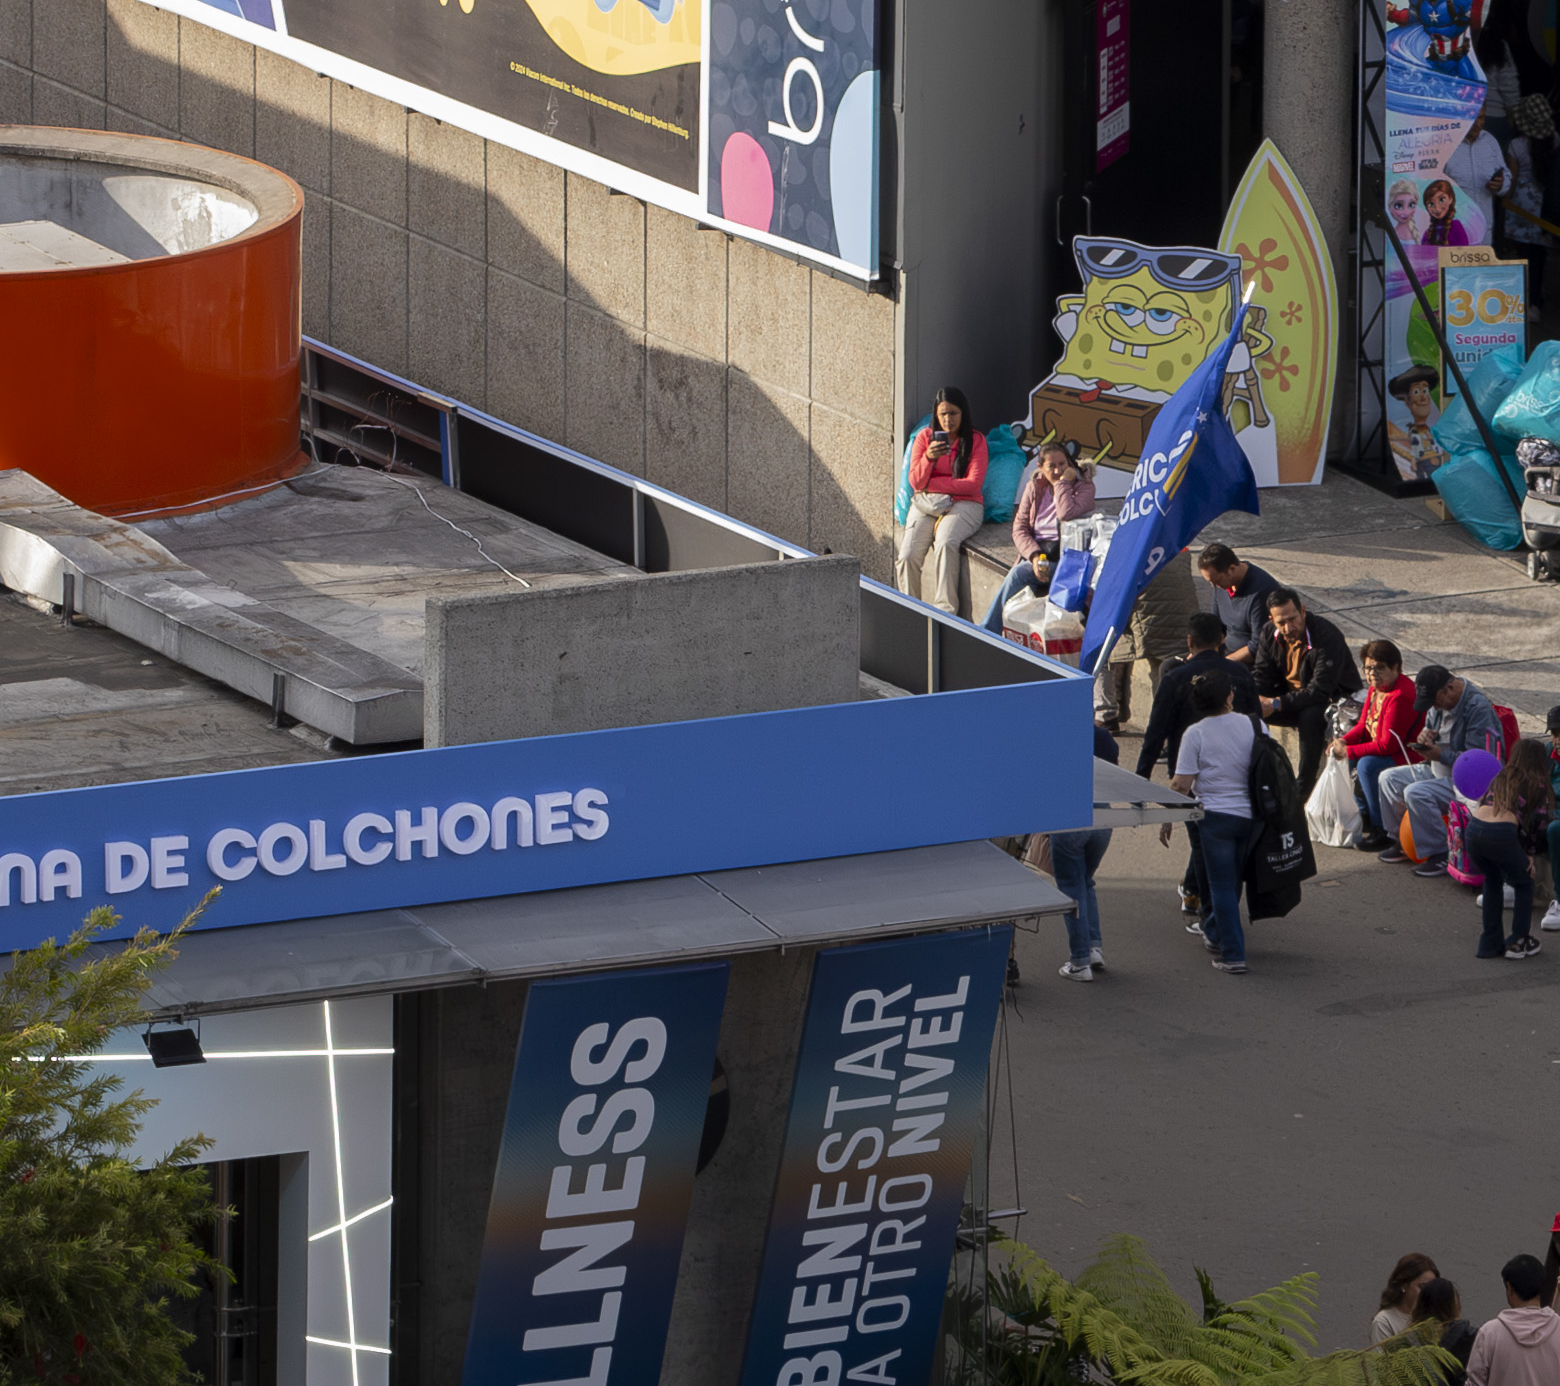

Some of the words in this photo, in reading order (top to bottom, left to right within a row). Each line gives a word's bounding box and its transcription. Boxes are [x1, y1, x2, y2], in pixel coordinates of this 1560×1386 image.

[1451, 252, 1490, 263] brissa
[1447, 289, 1524, 327] 30%
[1455, 333, 1517, 346] Segunda
[105, 835, 189, 894] DE
[206, 787, 610, 882] COLCHONES
[887, 974, 971, 1158] NIVEL
[856, 1172, 934, 1334] OTRO
